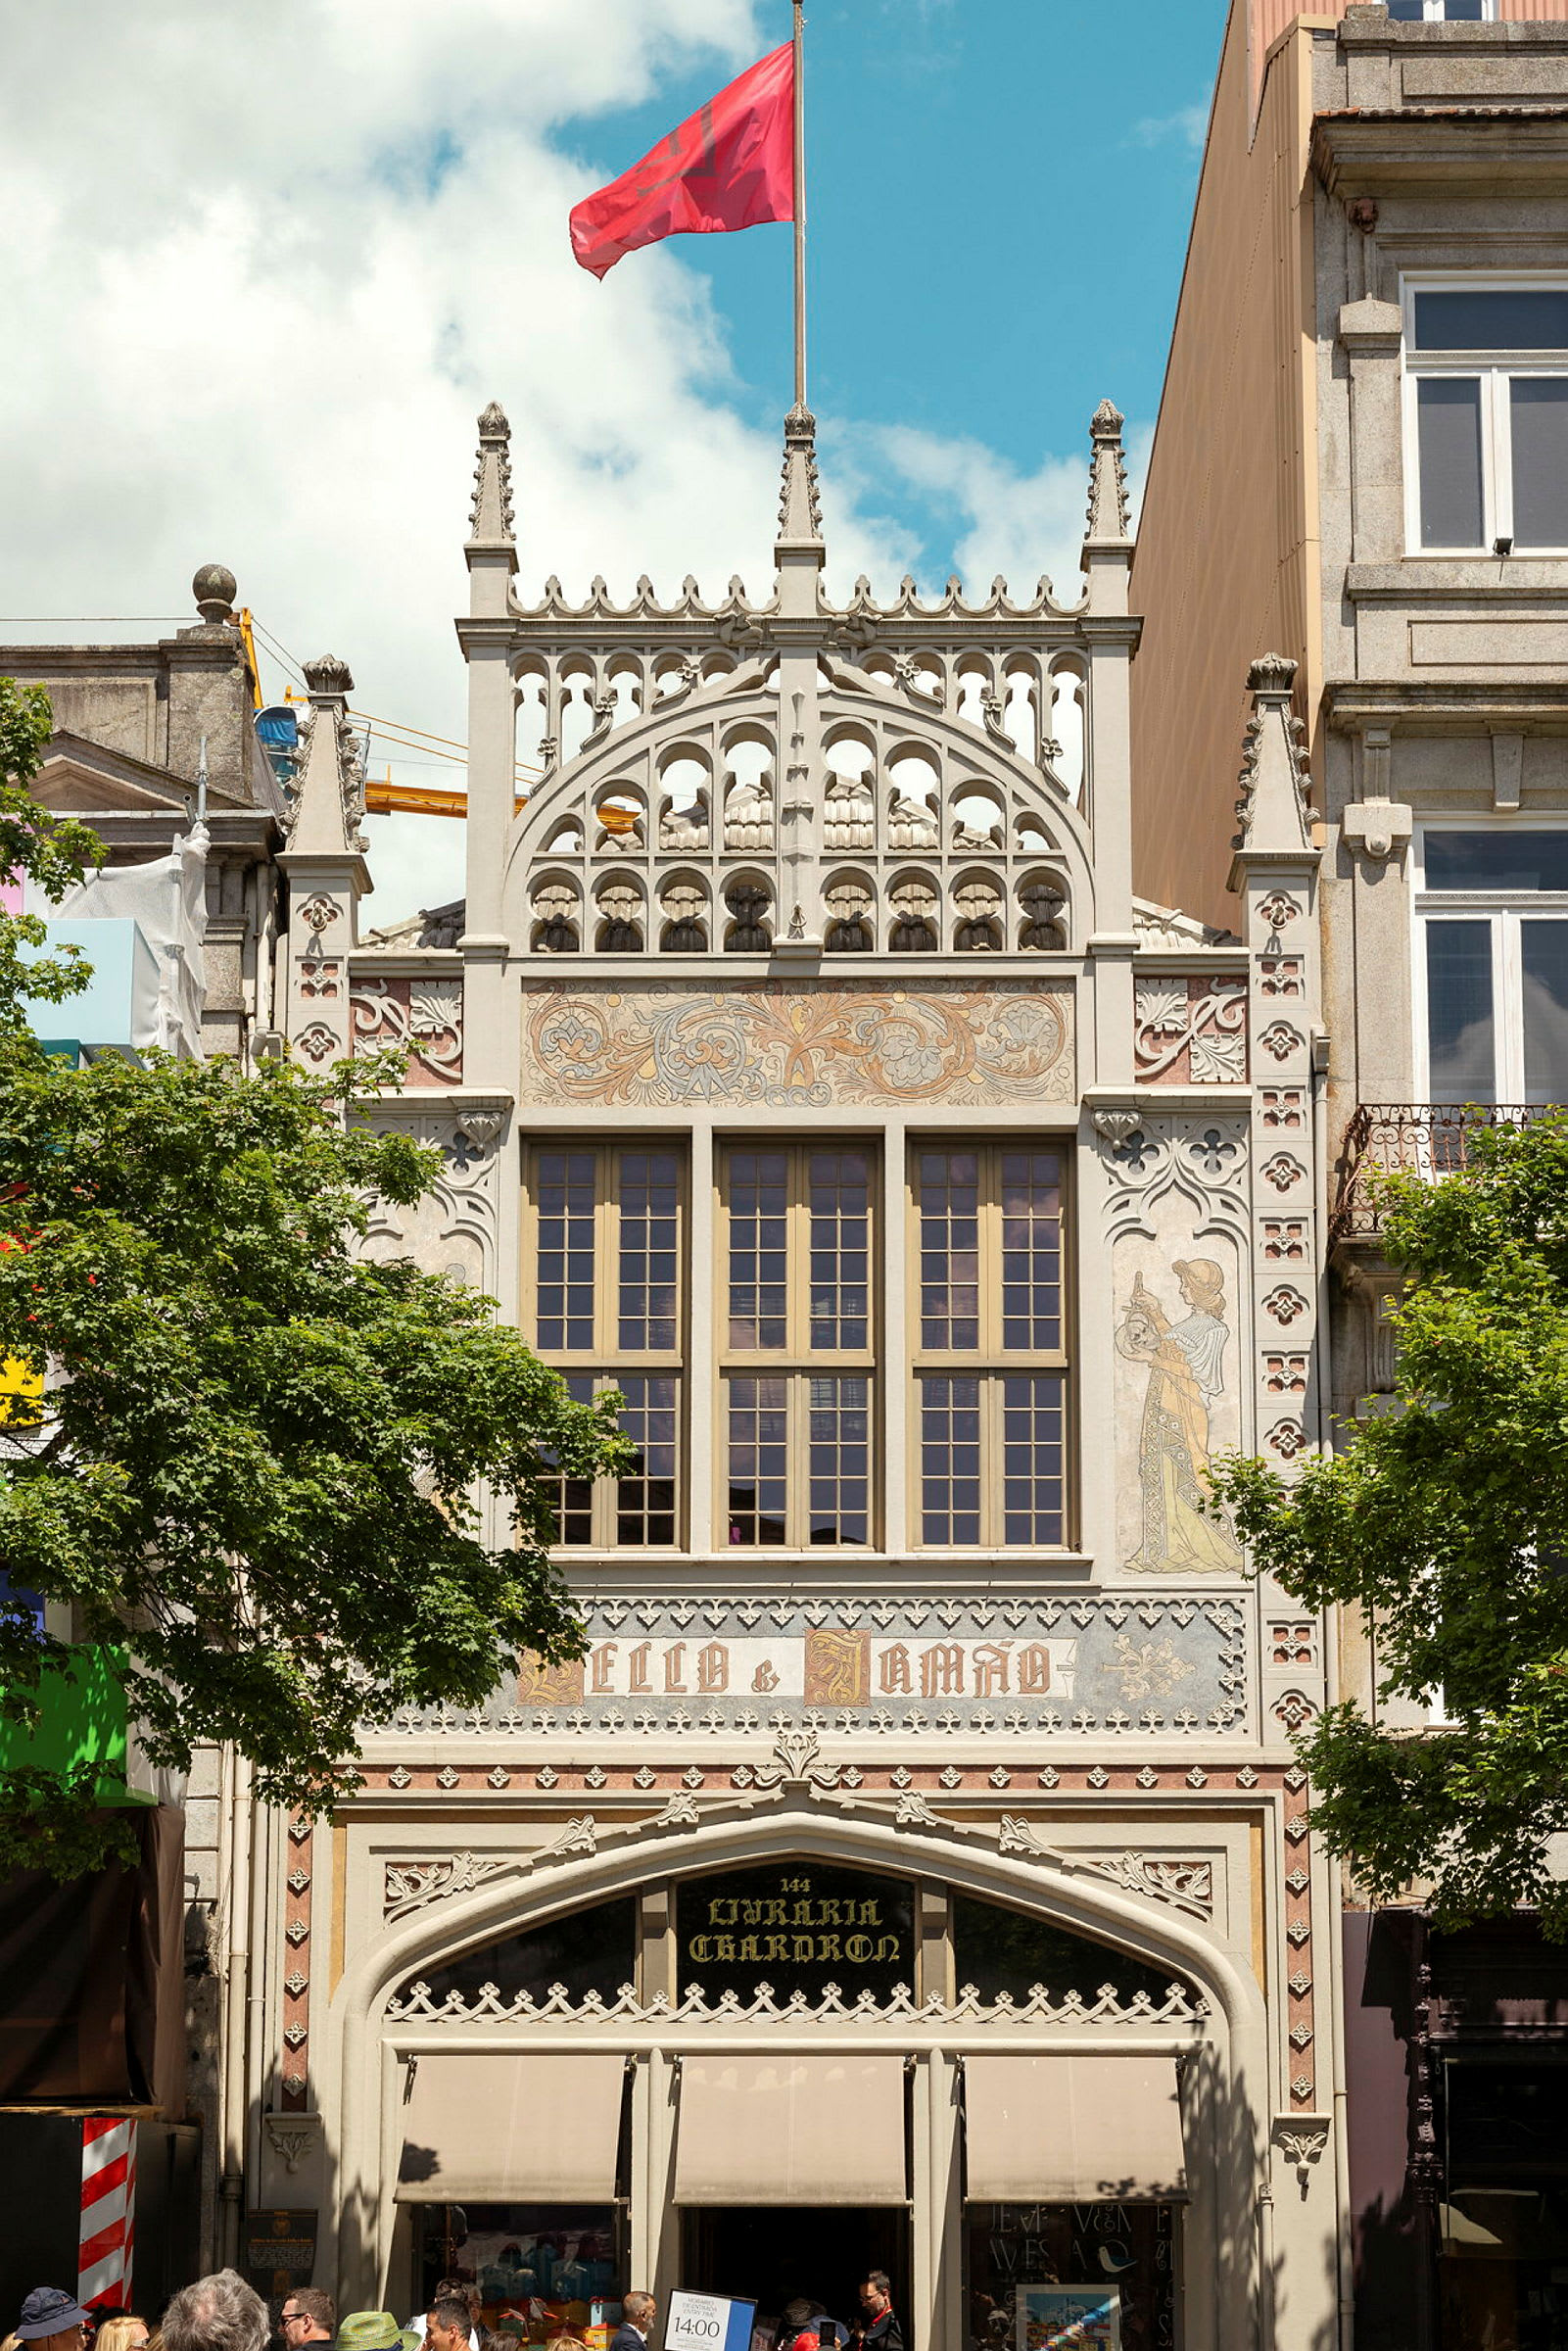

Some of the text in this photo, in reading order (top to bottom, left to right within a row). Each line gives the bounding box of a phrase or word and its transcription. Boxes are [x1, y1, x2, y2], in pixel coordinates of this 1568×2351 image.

[751, 1659, 781, 1693] &
[805, 1629, 1051, 1704] IRMÃO
[781, 1878, 811, 1893] 144
[707, 1898, 883, 1927] LIVRARIA
[689, 1934, 900, 1963] CHARDRON
[675, 2316, 720, 2338] 14:00
